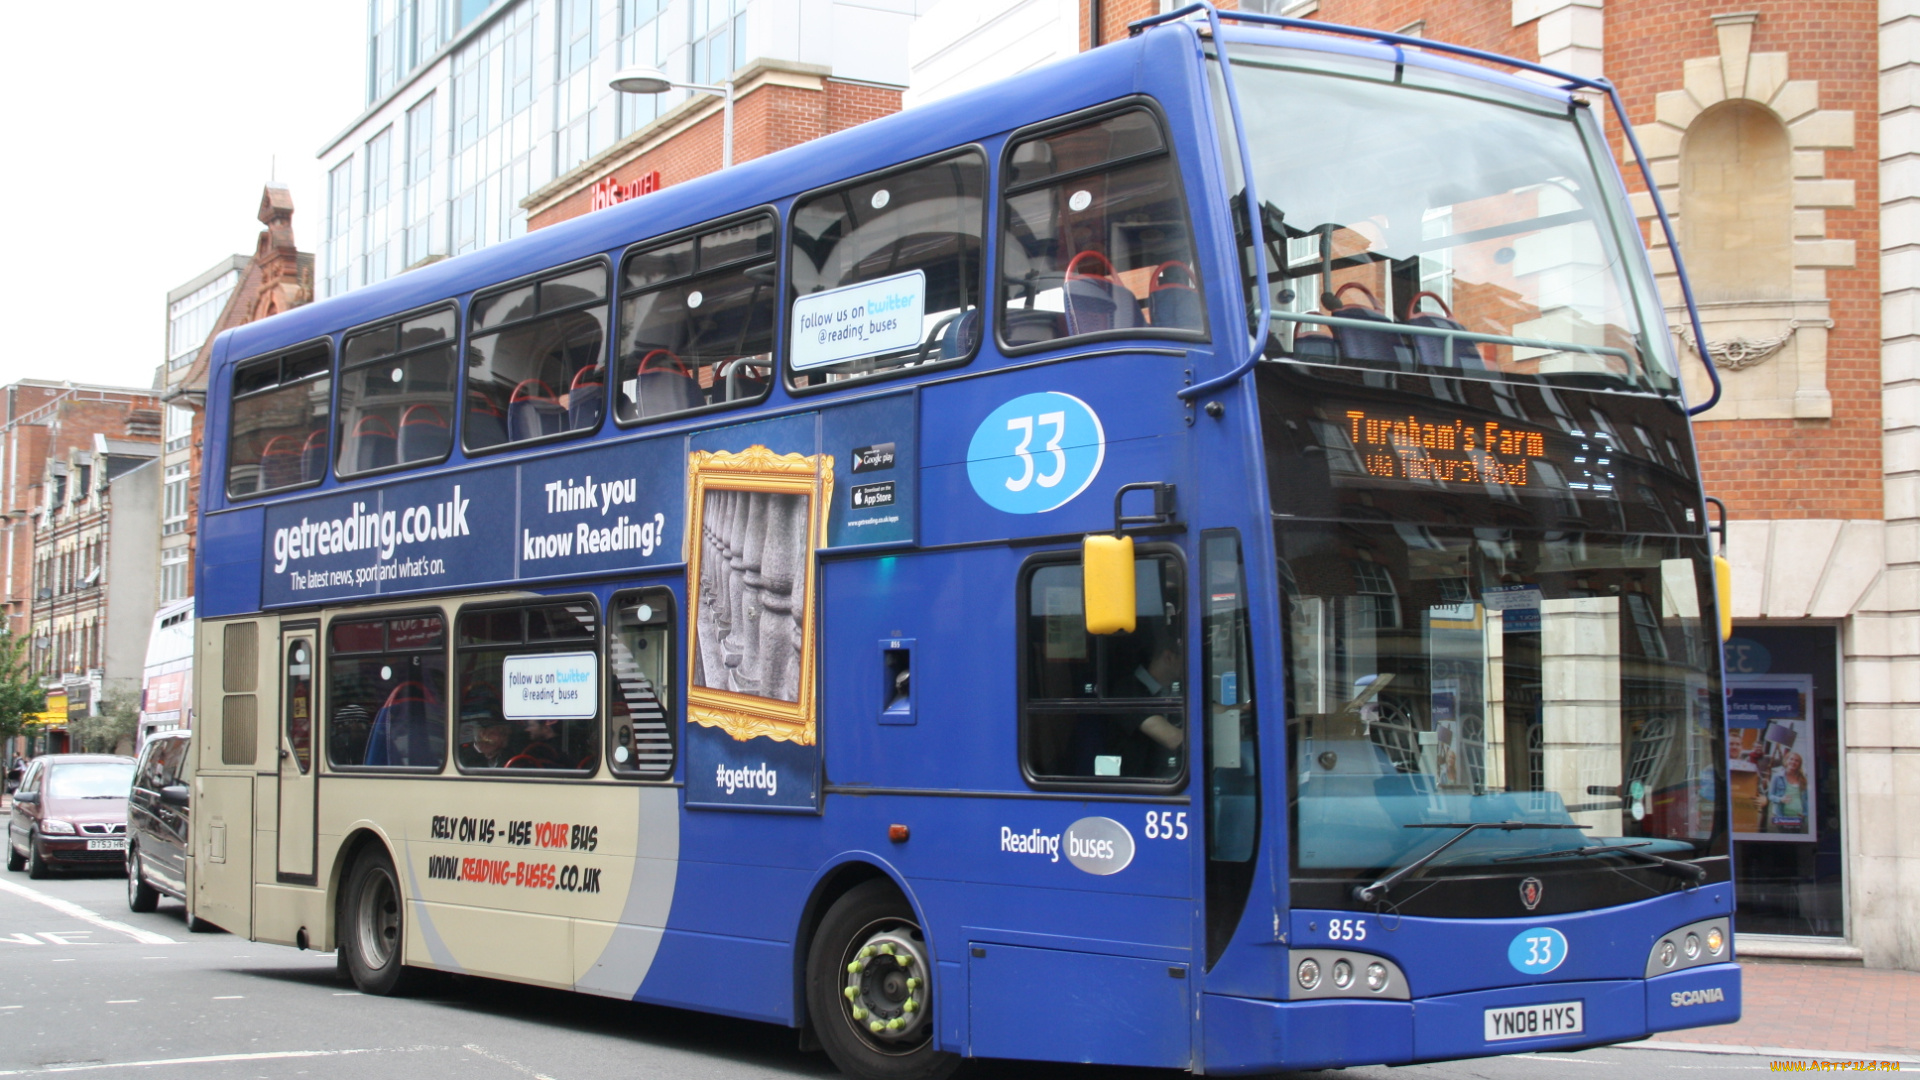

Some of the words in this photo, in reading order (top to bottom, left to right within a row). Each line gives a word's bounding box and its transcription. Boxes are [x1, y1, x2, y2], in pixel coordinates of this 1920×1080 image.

[800, 312, 833, 334] follow
[836, 309, 848, 323] us
[851, 305, 865, 319] on
[867, 293, 916, 316] twitter
[818, 318, 898, 345] @reading_buses
[1346, 410, 1475, 452] Turnham's
[1485, 421, 1544, 457] Farm
[863, 454, 883, 466] Google
[882, 453, 894, 464] play
[1004, 410, 1067, 492] 33
[1367, 448, 1394, 478] via
[1398, 449, 1480, 483] Tilehurst
[1483, 455, 1527, 486] Road
[545, 475, 599, 514] Think
[601, 478, 637, 516] you
[864, 493, 876, 506] App
[876, 492, 892, 503] Store
[273, 484, 471, 575] getreading.co.uk
[523, 528, 574, 561] know
[576, 512, 665, 557] Reading?
[290, 571, 306, 591] The
[307, 569, 329, 589] latest
[329, 568, 354, 587] news,
[355, 565, 378, 588] sport
[379, 558, 398, 581] and
[398, 555, 429, 578] what's
[430, 558, 446, 575] on.
[509, 671, 533, 688] follow
[535, 674, 543, 685] us
[545, 673, 555, 683] on
[556, 668, 590, 683] twitter
[522, 687, 579, 705] @reading_buses
[1733, 702, 1748, 711] first
[1749, 702, 1766, 711] time
[1767, 702, 1792, 712] buyers
[716, 762, 777, 796] #getrdg
[430, 815, 458, 840] RELY
[458, 816, 477, 843] ON
[478, 818, 495, 844] US
[507, 820, 533, 846] USE
[535, 821, 569, 848] YOUR
[570, 824, 598, 852] BUS
[1144, 810, 1189, 840] 855
[1000, 826, 1060, 862] Reading
[1069, 830, 1114, 860] buses
[428, 854, 602, 894] WWW.READING-BUSES.CO.UK
[1328, 918, 1366, 941] 855
[1524, 936, 1552, 966] 33
[1670, 987, 1725, 1008] SCANIA
[1491, 1009, 1538, 1036] YN08
[1542, 1006, 1576, 1032] HYS
